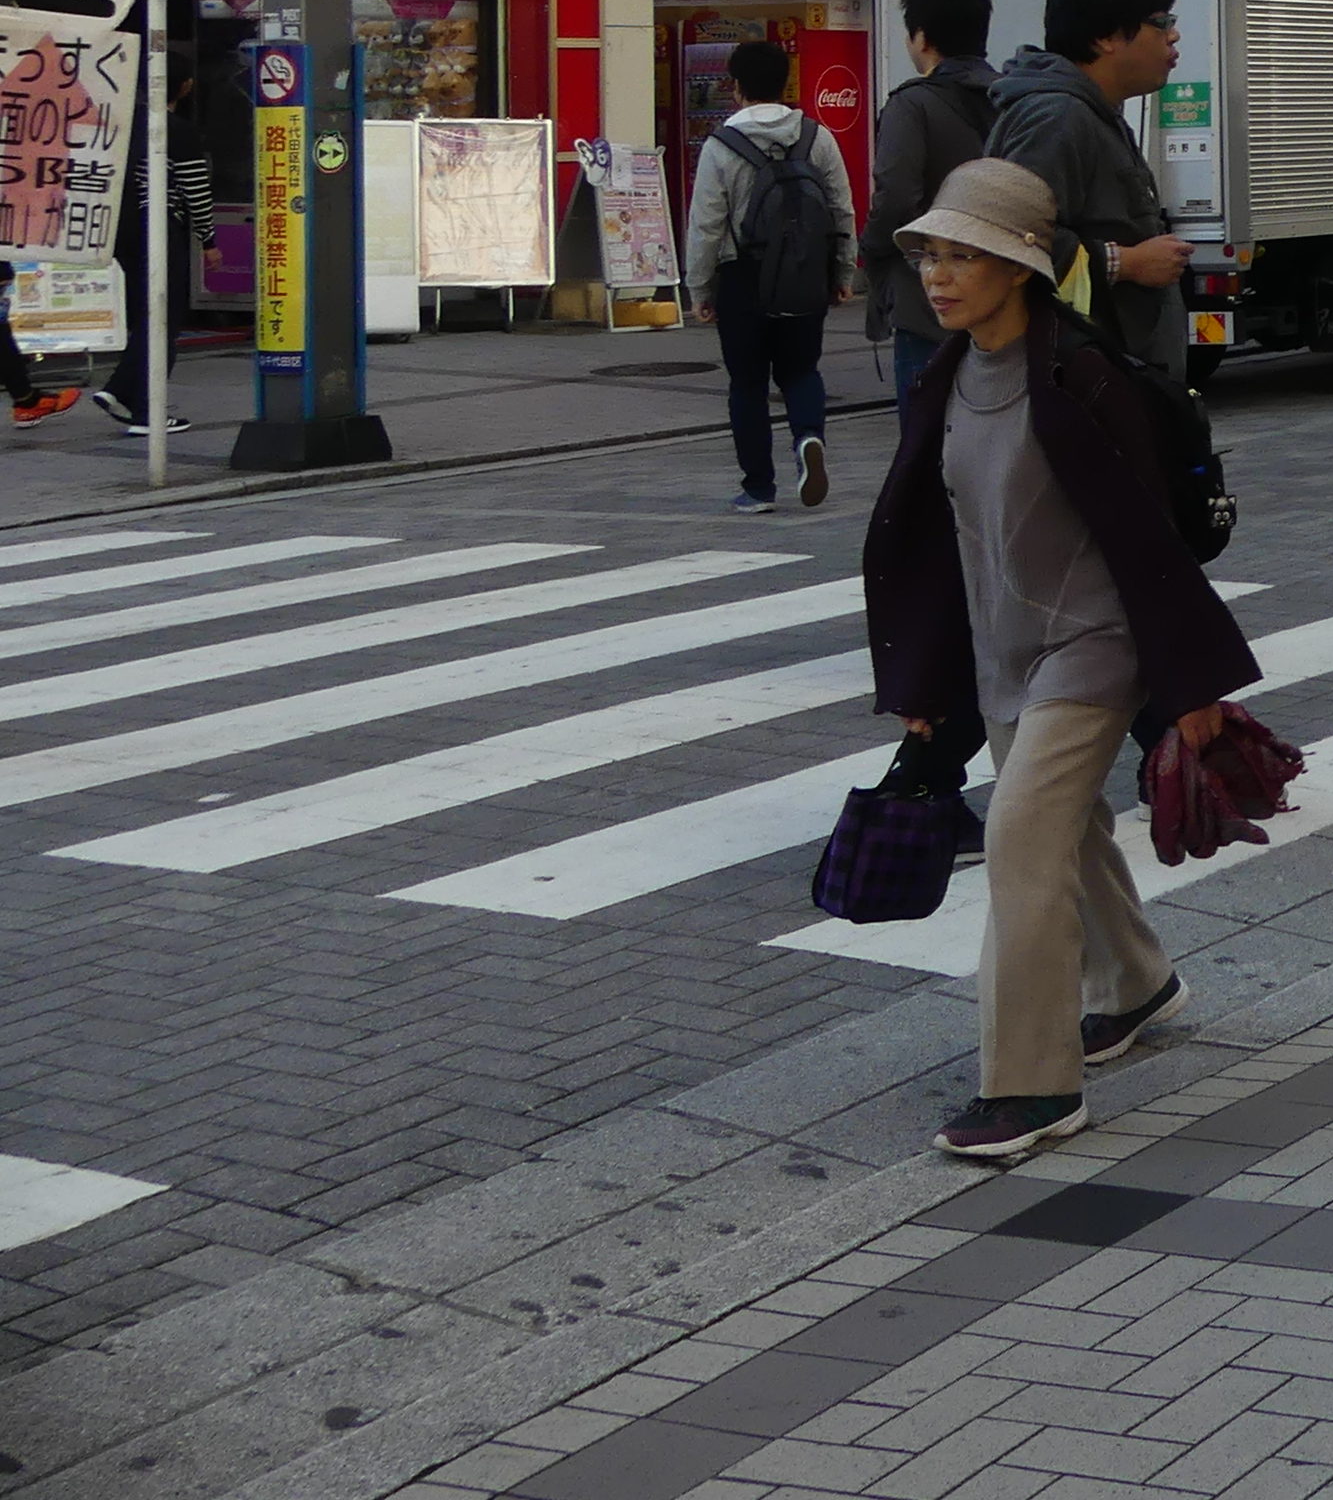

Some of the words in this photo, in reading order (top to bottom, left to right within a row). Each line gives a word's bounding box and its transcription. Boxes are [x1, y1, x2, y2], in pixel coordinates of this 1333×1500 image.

[288, 114, 301, 188] 千代田区内は
[265, 125, 288, 343] 路上喫煙禁止です。
